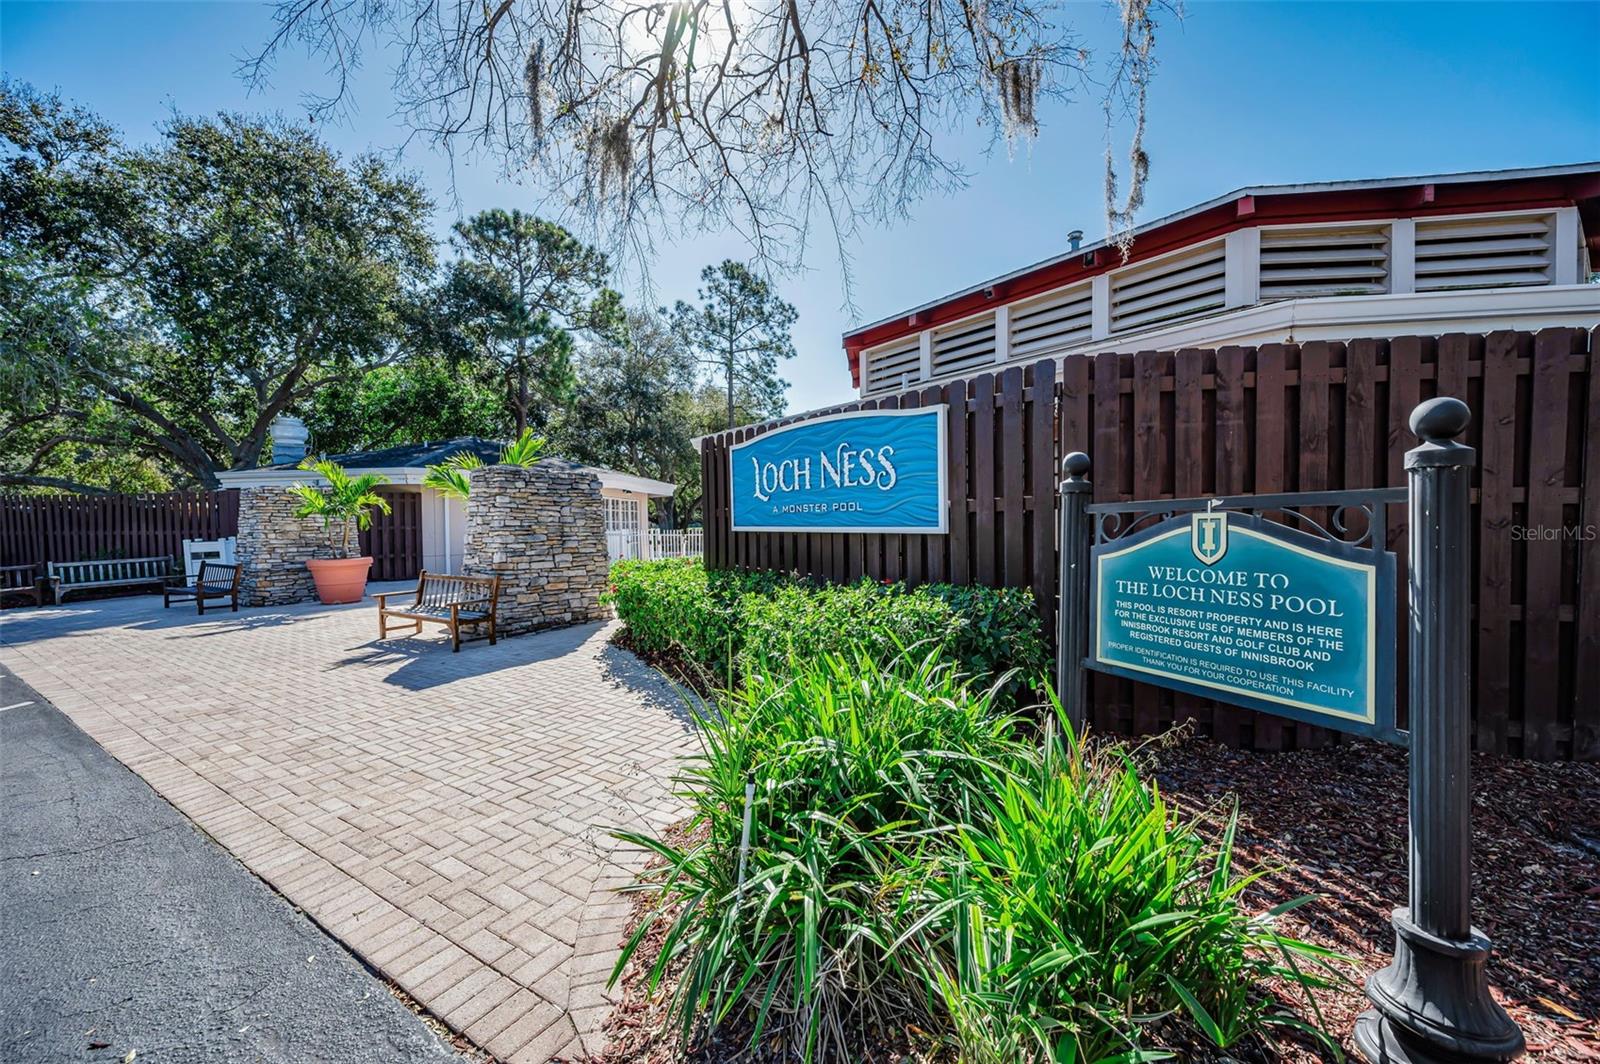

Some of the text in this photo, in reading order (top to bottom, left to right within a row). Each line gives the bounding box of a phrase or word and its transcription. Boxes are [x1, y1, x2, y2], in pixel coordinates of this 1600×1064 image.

[752, 443, 897, 502] LOCH NESS
[773, 502, 863, 513] A MONSTER POOL
[1148, 565, 1289, 589] WELCOME TO
[1115, 580, 1344, 617] THE LOCH NESS POOL
[1115, 600, 1343, 638] THIS POOL IS RESORT PROPERTY AND IS HERE
[1114, 609, 1344, 651] FOR THE EXCLUSIVE USE OF MEMBERS OF THE
[1120, 619, 1331, 662] INNISBROOK RESORT AND GOLF CLUB AND
[1107, 641, 1354, 698] PROPER IDENTIFICATION IS REQUIRED TO USE THIS FACILITY
[1129, 630, 1314, 672] REGISTERED GUESTS OF INNISBROOK
[1142, 656, 1294, 696] THANK YOU FOR YOUR COOPERATION
